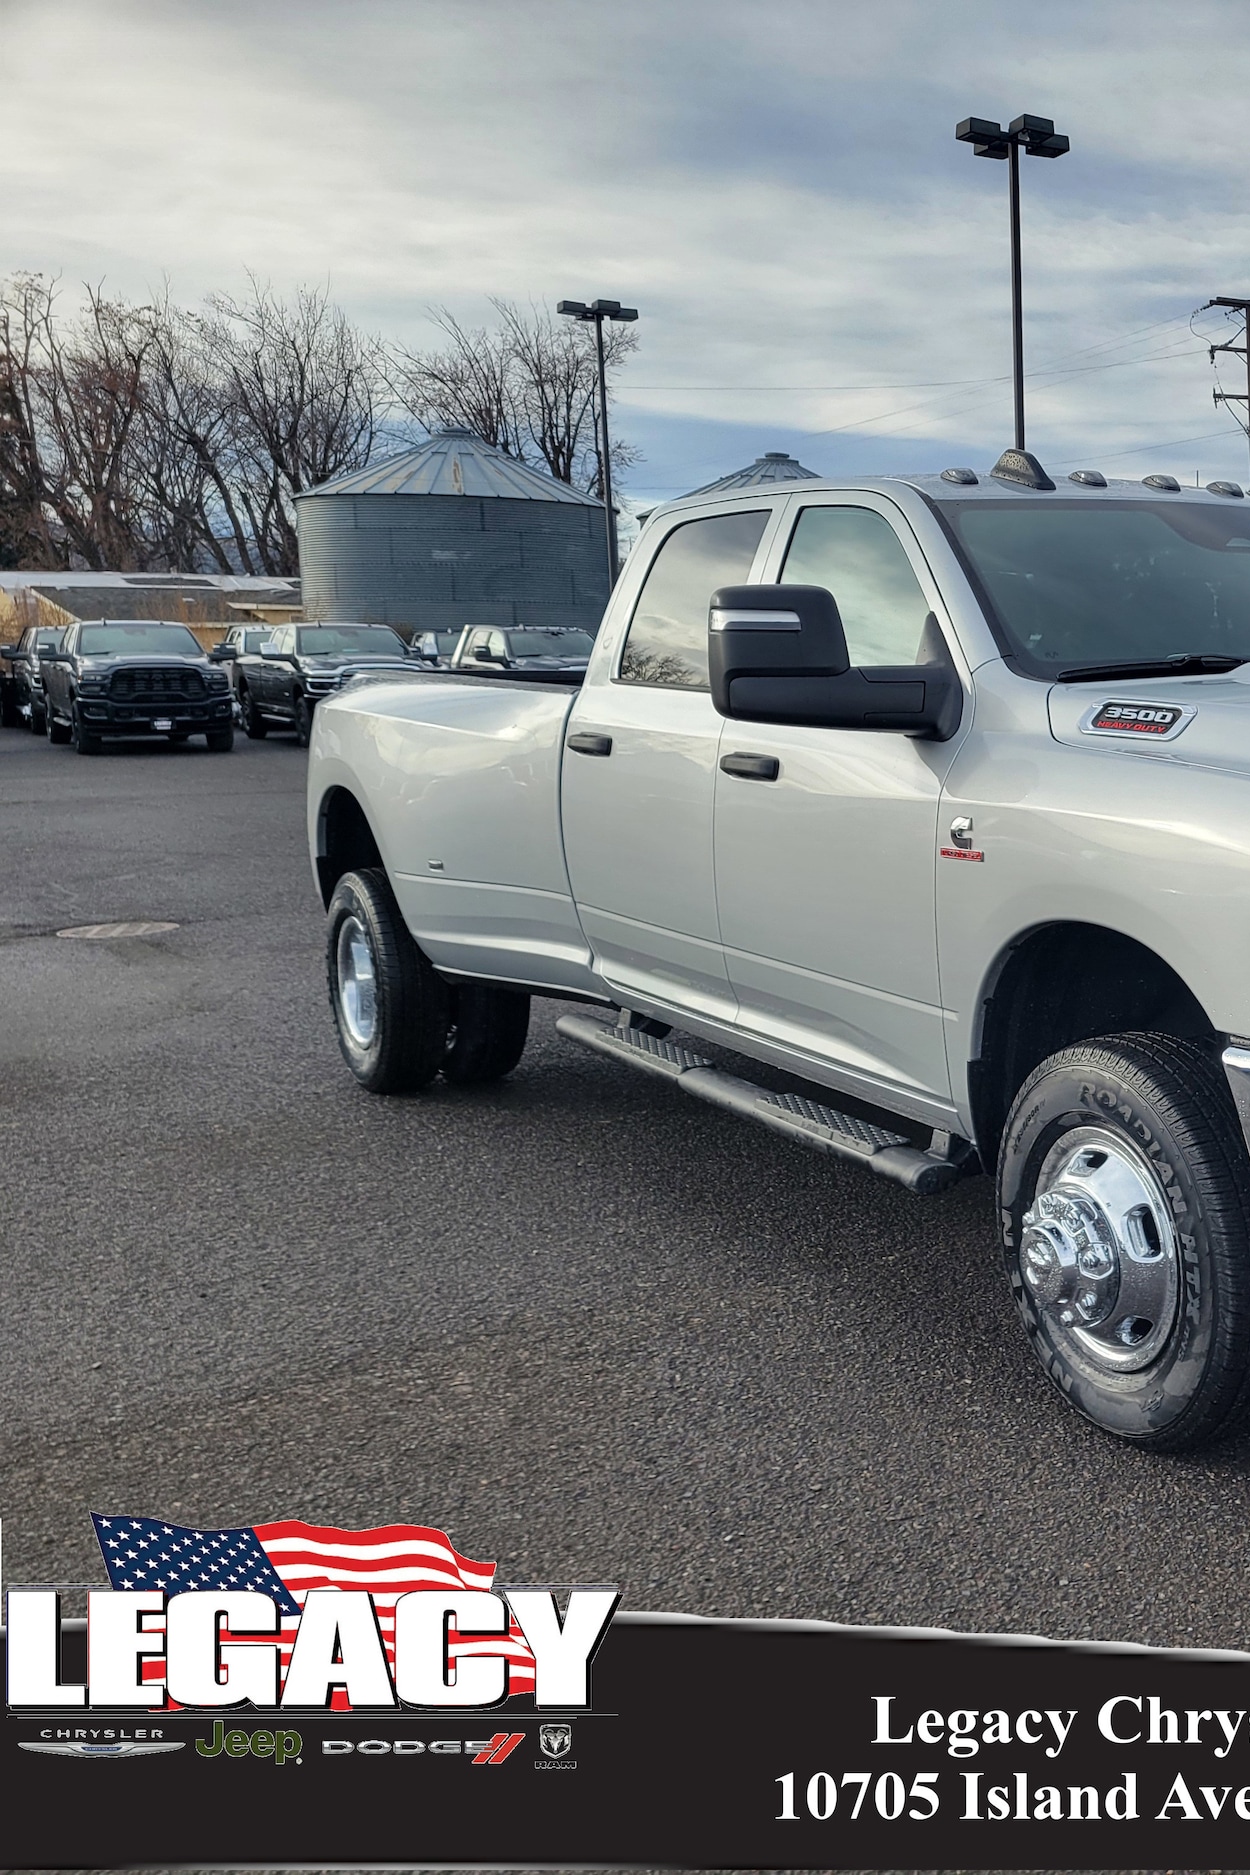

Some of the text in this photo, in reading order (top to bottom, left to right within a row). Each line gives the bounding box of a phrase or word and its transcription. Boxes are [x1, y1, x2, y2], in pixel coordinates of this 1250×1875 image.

[1104, 706, 1174, 724] 3500
[1096, 720, 1166, 733] HEAVY DUTY
[1080, 1082, 1187, 1214] ROADIAN
